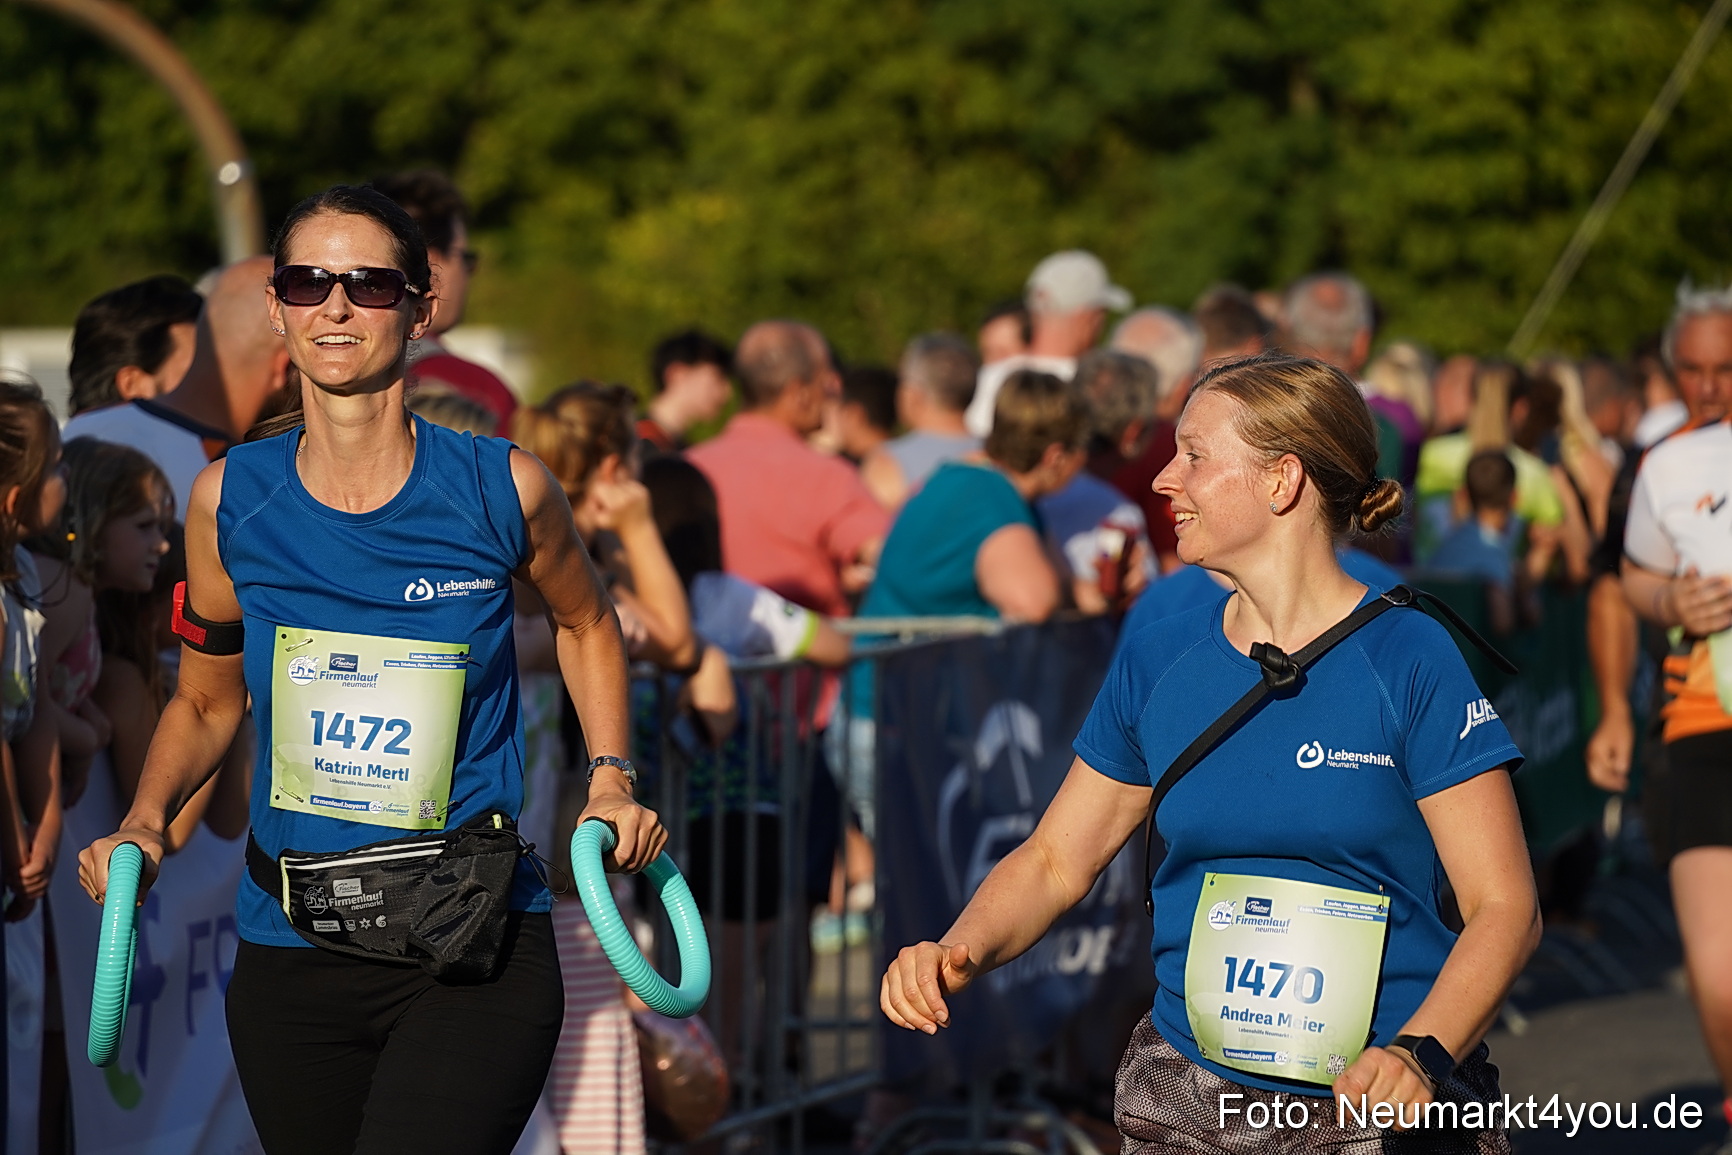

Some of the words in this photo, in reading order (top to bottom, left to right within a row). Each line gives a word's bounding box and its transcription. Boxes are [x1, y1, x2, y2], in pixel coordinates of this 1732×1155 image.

[436, 578, 496, 593] Lebenshilfe
[437, 590, 470, 598] Neumarkt
[319, 671, 379, 682] Firmenlauf
[341, 681, 377, 689] neumarkt
[310, 709, 412, 756] 1472
[314, 756, 363, 777] Katrin
[366, 763, 410, 782] Mertl
[1326, 760, 1360, 770] Neumarkt
[329, 777, 357, 787] Lebenshilfe
[357, 781, 383, 789] Neumarkt
[312, 797, 367, 810] firmenlauf.bayern
[328, 889, 384, 907] Firmenlauf
[351, 899, 384, 911] neumarkt
[1235, 914, 1292, 928] Firmenlauf
[1254, 926, 1289, 934] neumarkt
[1224, 955, 1325, 1005] 1470
[1220, 1004, 1273, 1026] Andrea
[1277, 1011, 1326, 1033] Mier
[1238, 1026, 1265, 1035] Lebenshilfe
[1225, 1049, 1273, 1061] firmenlauf.bayern
